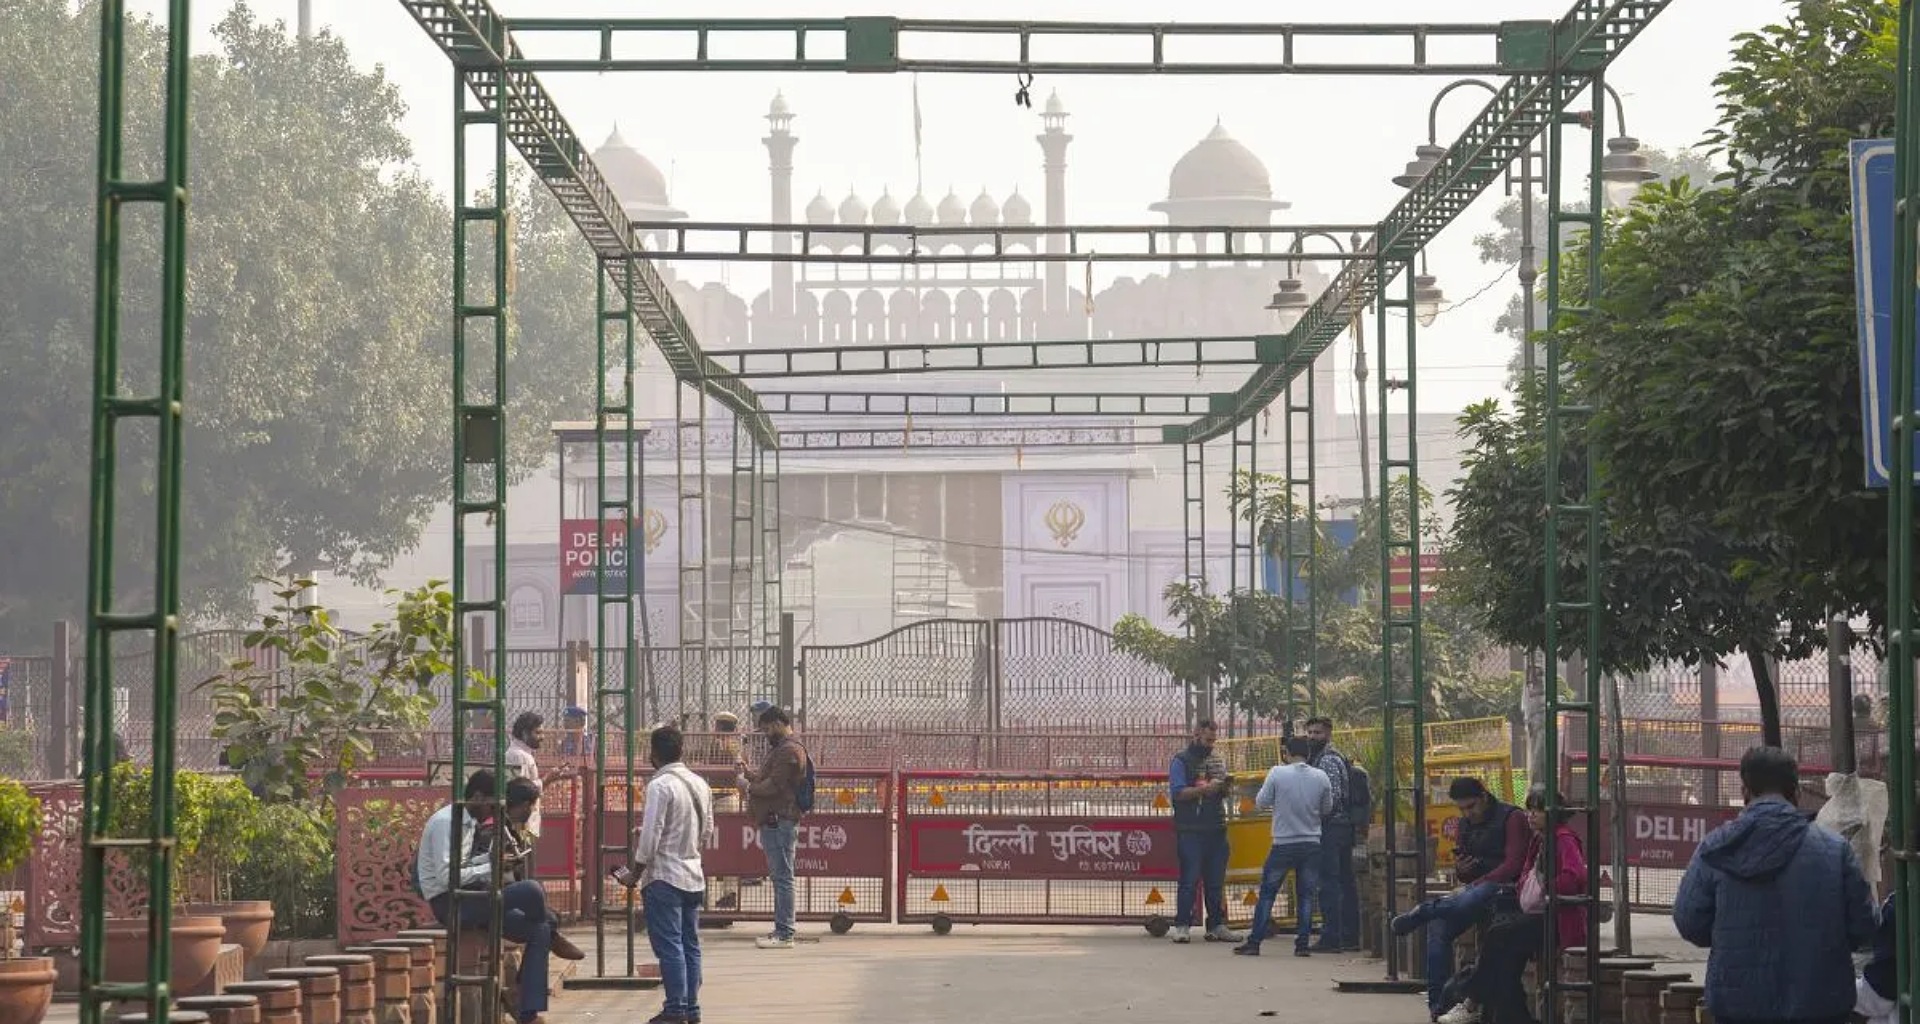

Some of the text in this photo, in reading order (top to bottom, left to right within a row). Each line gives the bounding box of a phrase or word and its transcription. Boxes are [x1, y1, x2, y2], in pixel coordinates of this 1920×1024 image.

[572, 532, 628, 547] DEH
[1636, 815, 1707, 842] DELHI
[962, 823, 1038, 857] दिल्ली
[1046, 825, 1122, 860] पुलिस
[794, 859, 828, 871] OTWALI
